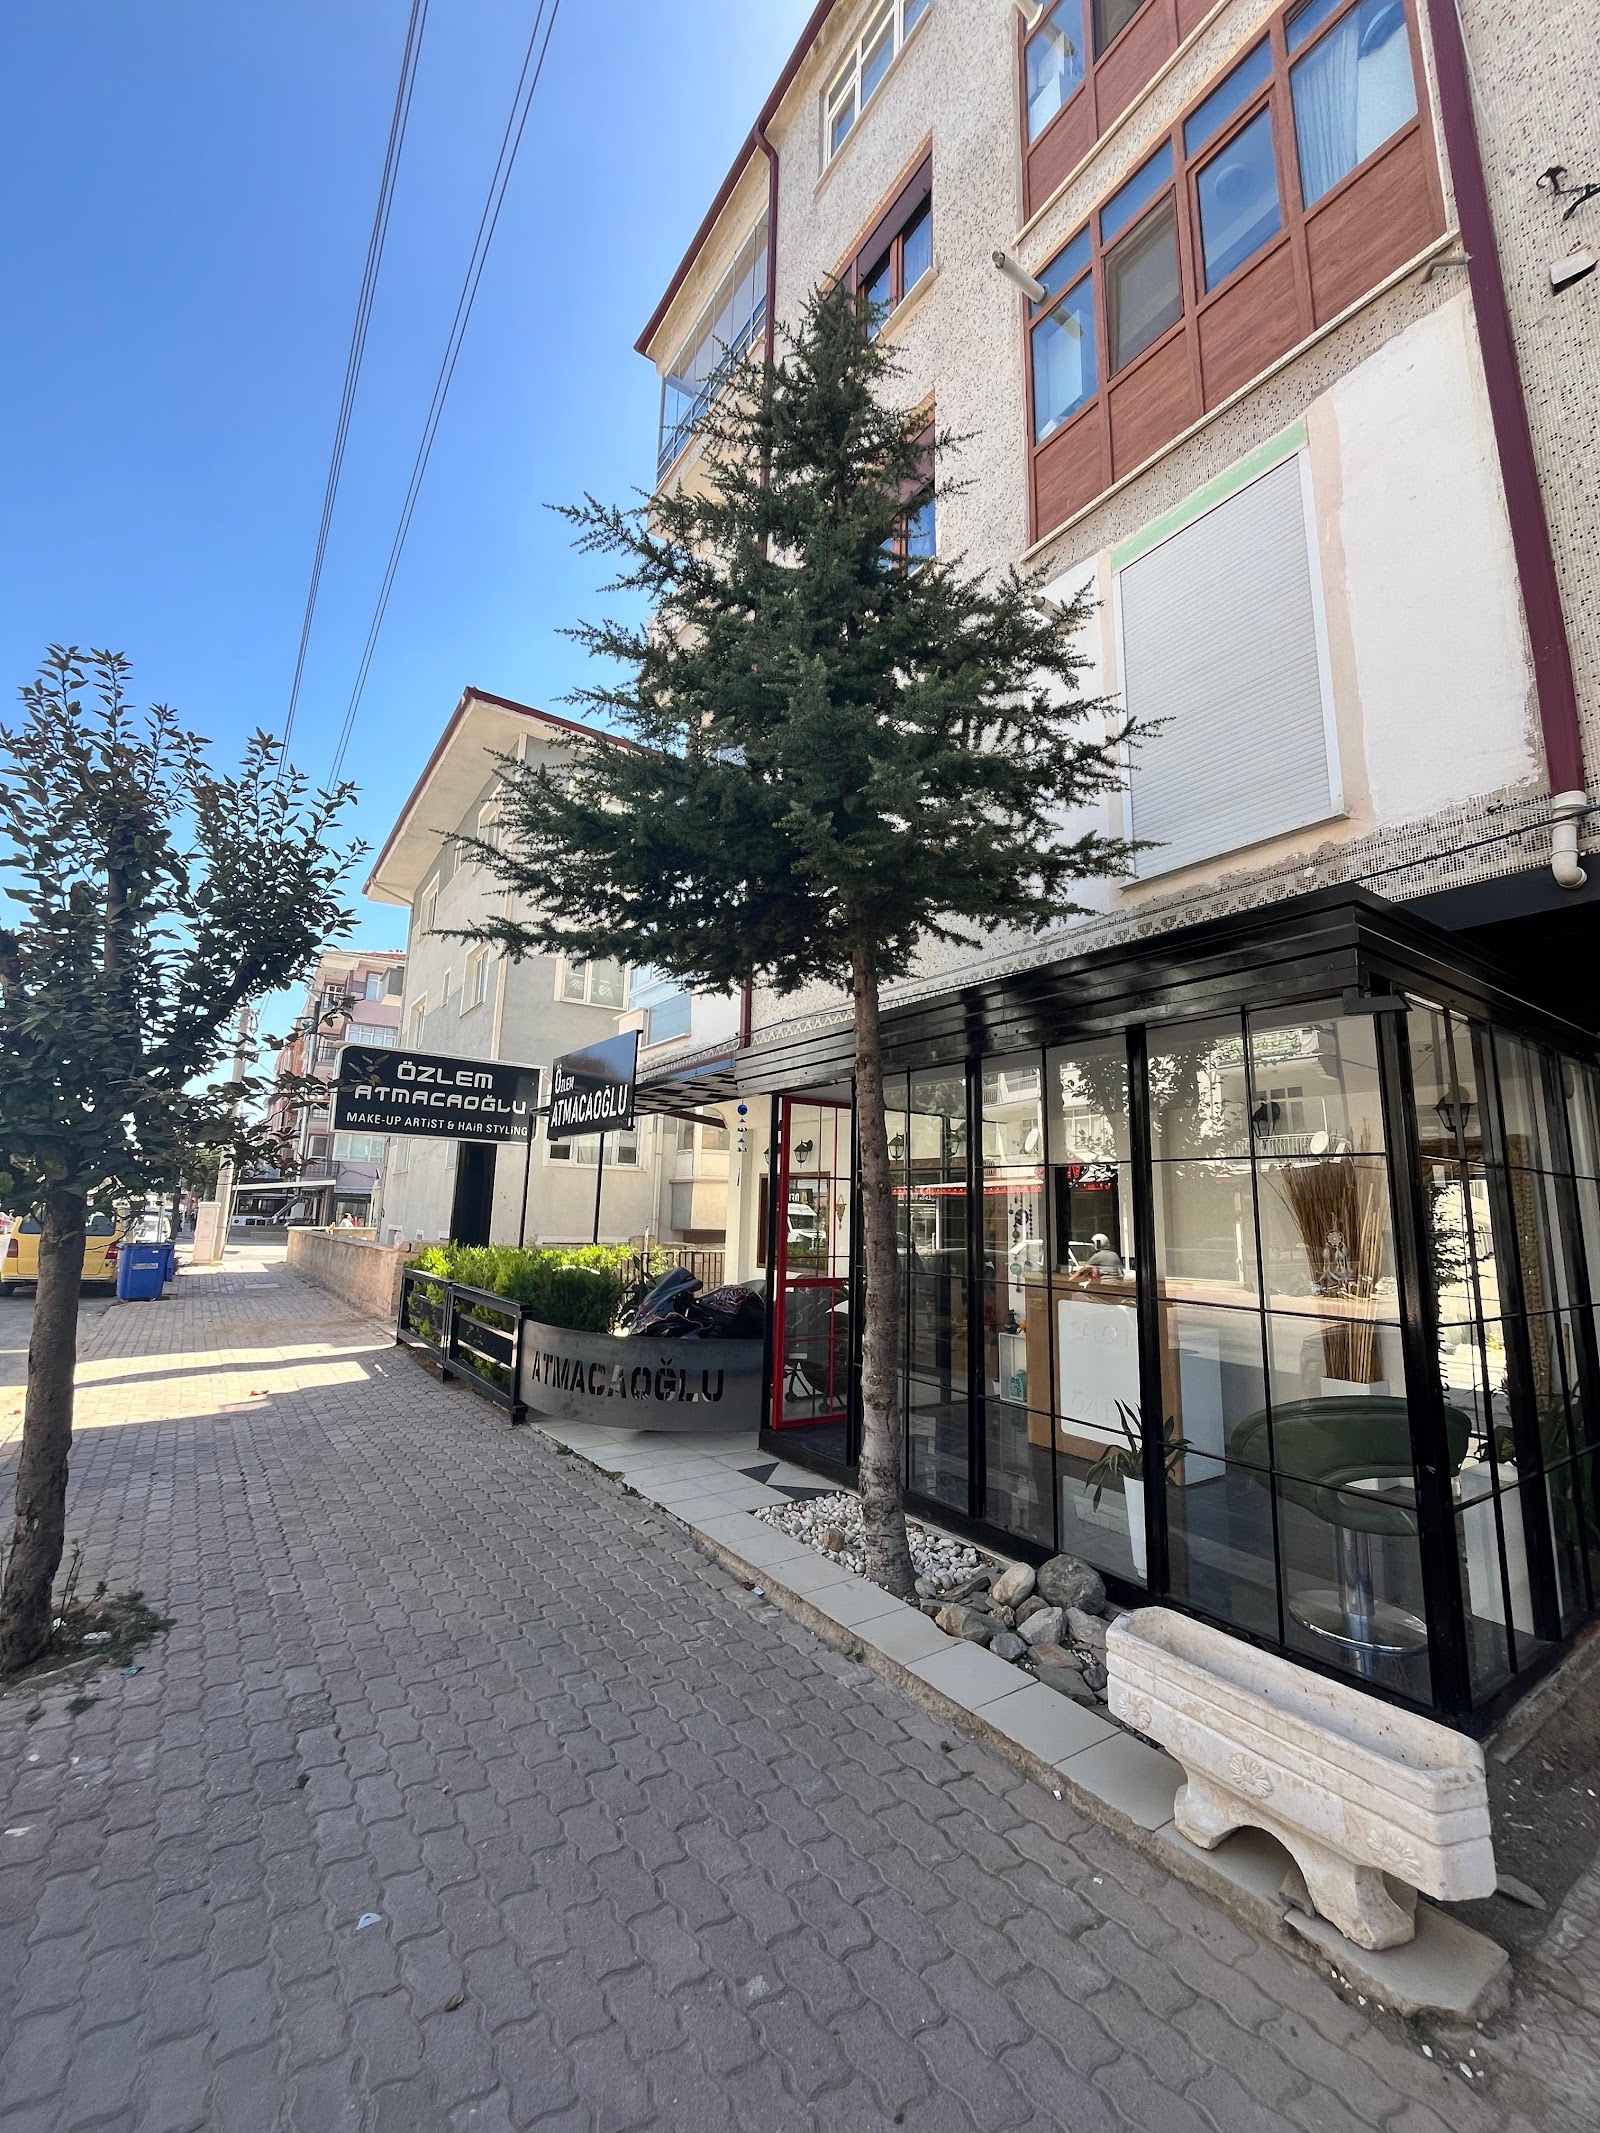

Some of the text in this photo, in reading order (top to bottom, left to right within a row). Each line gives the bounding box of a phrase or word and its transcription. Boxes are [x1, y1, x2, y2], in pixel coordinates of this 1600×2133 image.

[397, 1060, 493, 1090] ÖZLEM
[554, 1064, 575, 1095] ÖZLEM
[354, 1084, 527, 1115] ATMACAOĞLU
[550, 1084, 629, 1128] ATMACAOĞLU
[346, 1111, 402, 1126] MAKE-UP
[447, 1120, 455, 1130] &
[531, 1350, 725, 1403] ATMACAOĞLU
